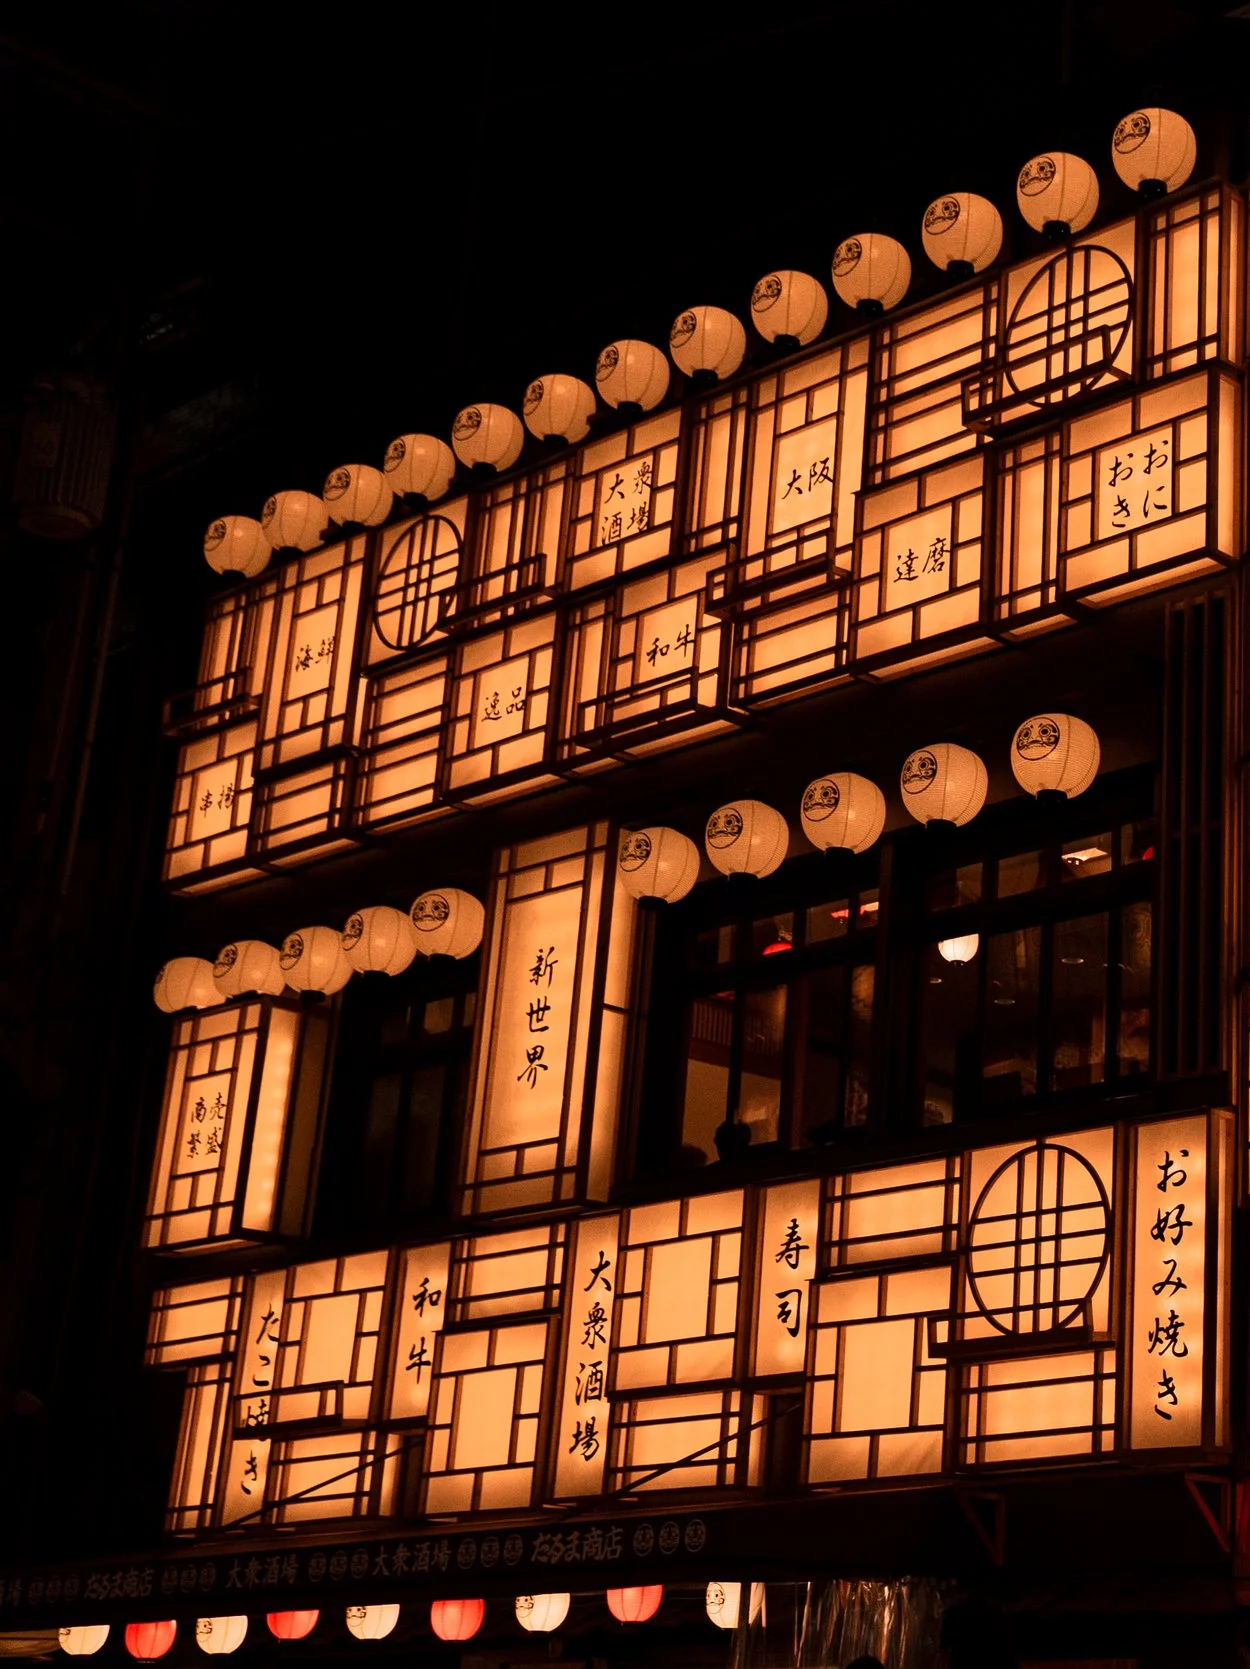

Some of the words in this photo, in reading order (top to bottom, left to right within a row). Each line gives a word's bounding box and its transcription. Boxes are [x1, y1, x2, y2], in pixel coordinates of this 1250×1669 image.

[604, 460, 654, 504] 大衆
[781, 457, 835, 500] 大阪
[601, 501, 650, 545] 酒場
[893, 537, 951, 583] 達磨
[645, 624, 696, 667] 和牛
[481, 685, 527, 721] 逸品
[517, 947, 558, 1090] 新世界
[774, 1217, 810, 1338] 寿司
[1148, 1149, 1193, 1421] お好み焼き
[405, 1277, 442, 1385] 和牛
[568, 1251, 612, 1462] 大衆酒場
[224, 1553, 300, 1589] 大衆酒場
[371, 1538, 452, 1578] 大衆酒場
[530, 1525, 625, 1565] だるま商店
